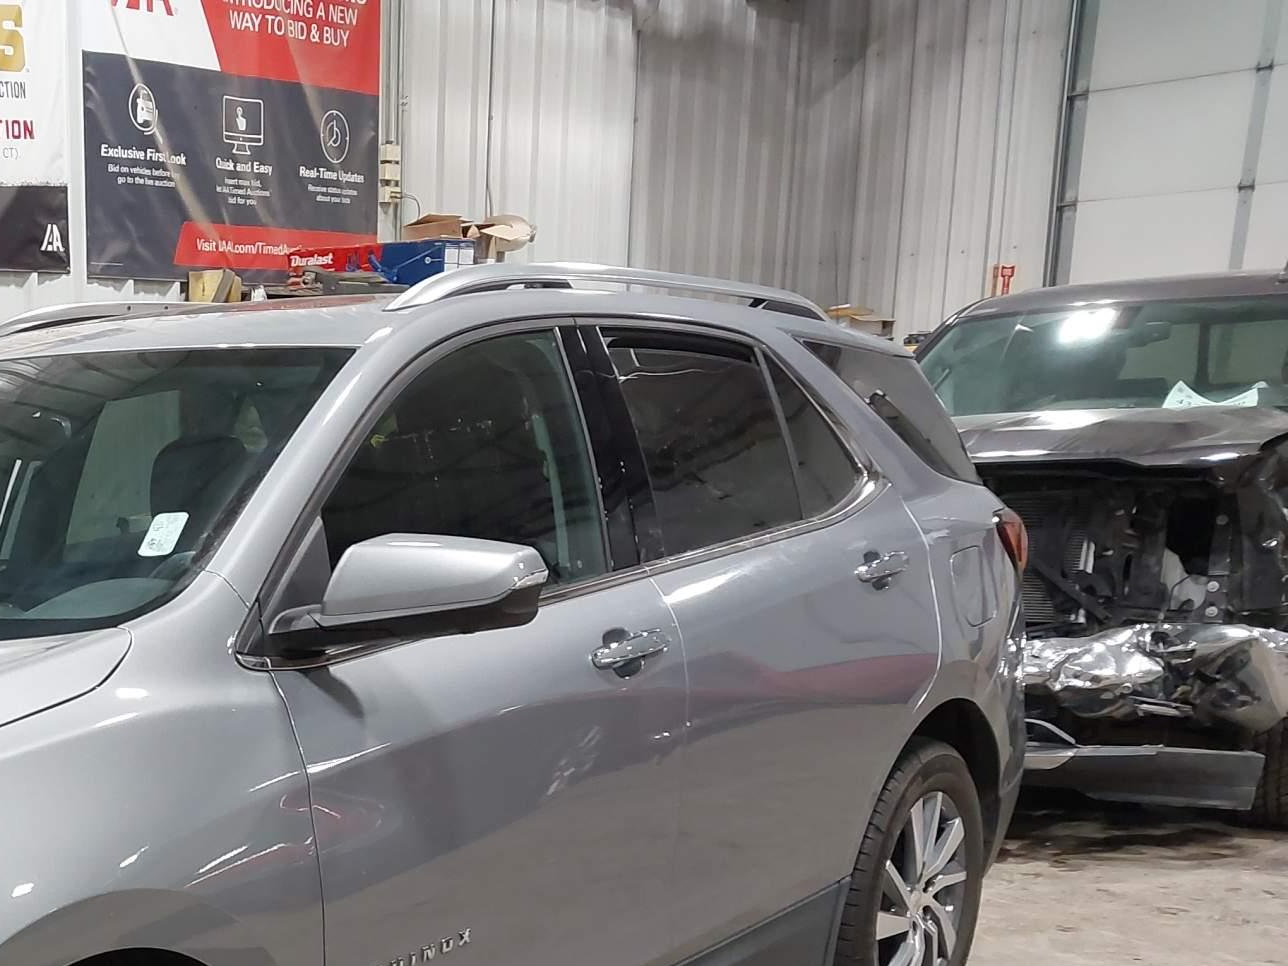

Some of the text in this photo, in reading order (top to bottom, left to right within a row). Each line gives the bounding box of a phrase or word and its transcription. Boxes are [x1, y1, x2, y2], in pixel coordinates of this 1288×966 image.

[316, 3, 326, 21] A
[328, 4, 358, 26] NEW
[229, 10, 350, 48] WAY TO BID & BUY
[100, 143, 145, 160] Exclusive
[146, 148, 167, 163] First
[215, 156, 273, 176] Quick and Easy
[299, 165, 365, 184] Real-Time Updates
[196, 237, 217, 252] Visit
[289, 252, 334, 267] Duralast
